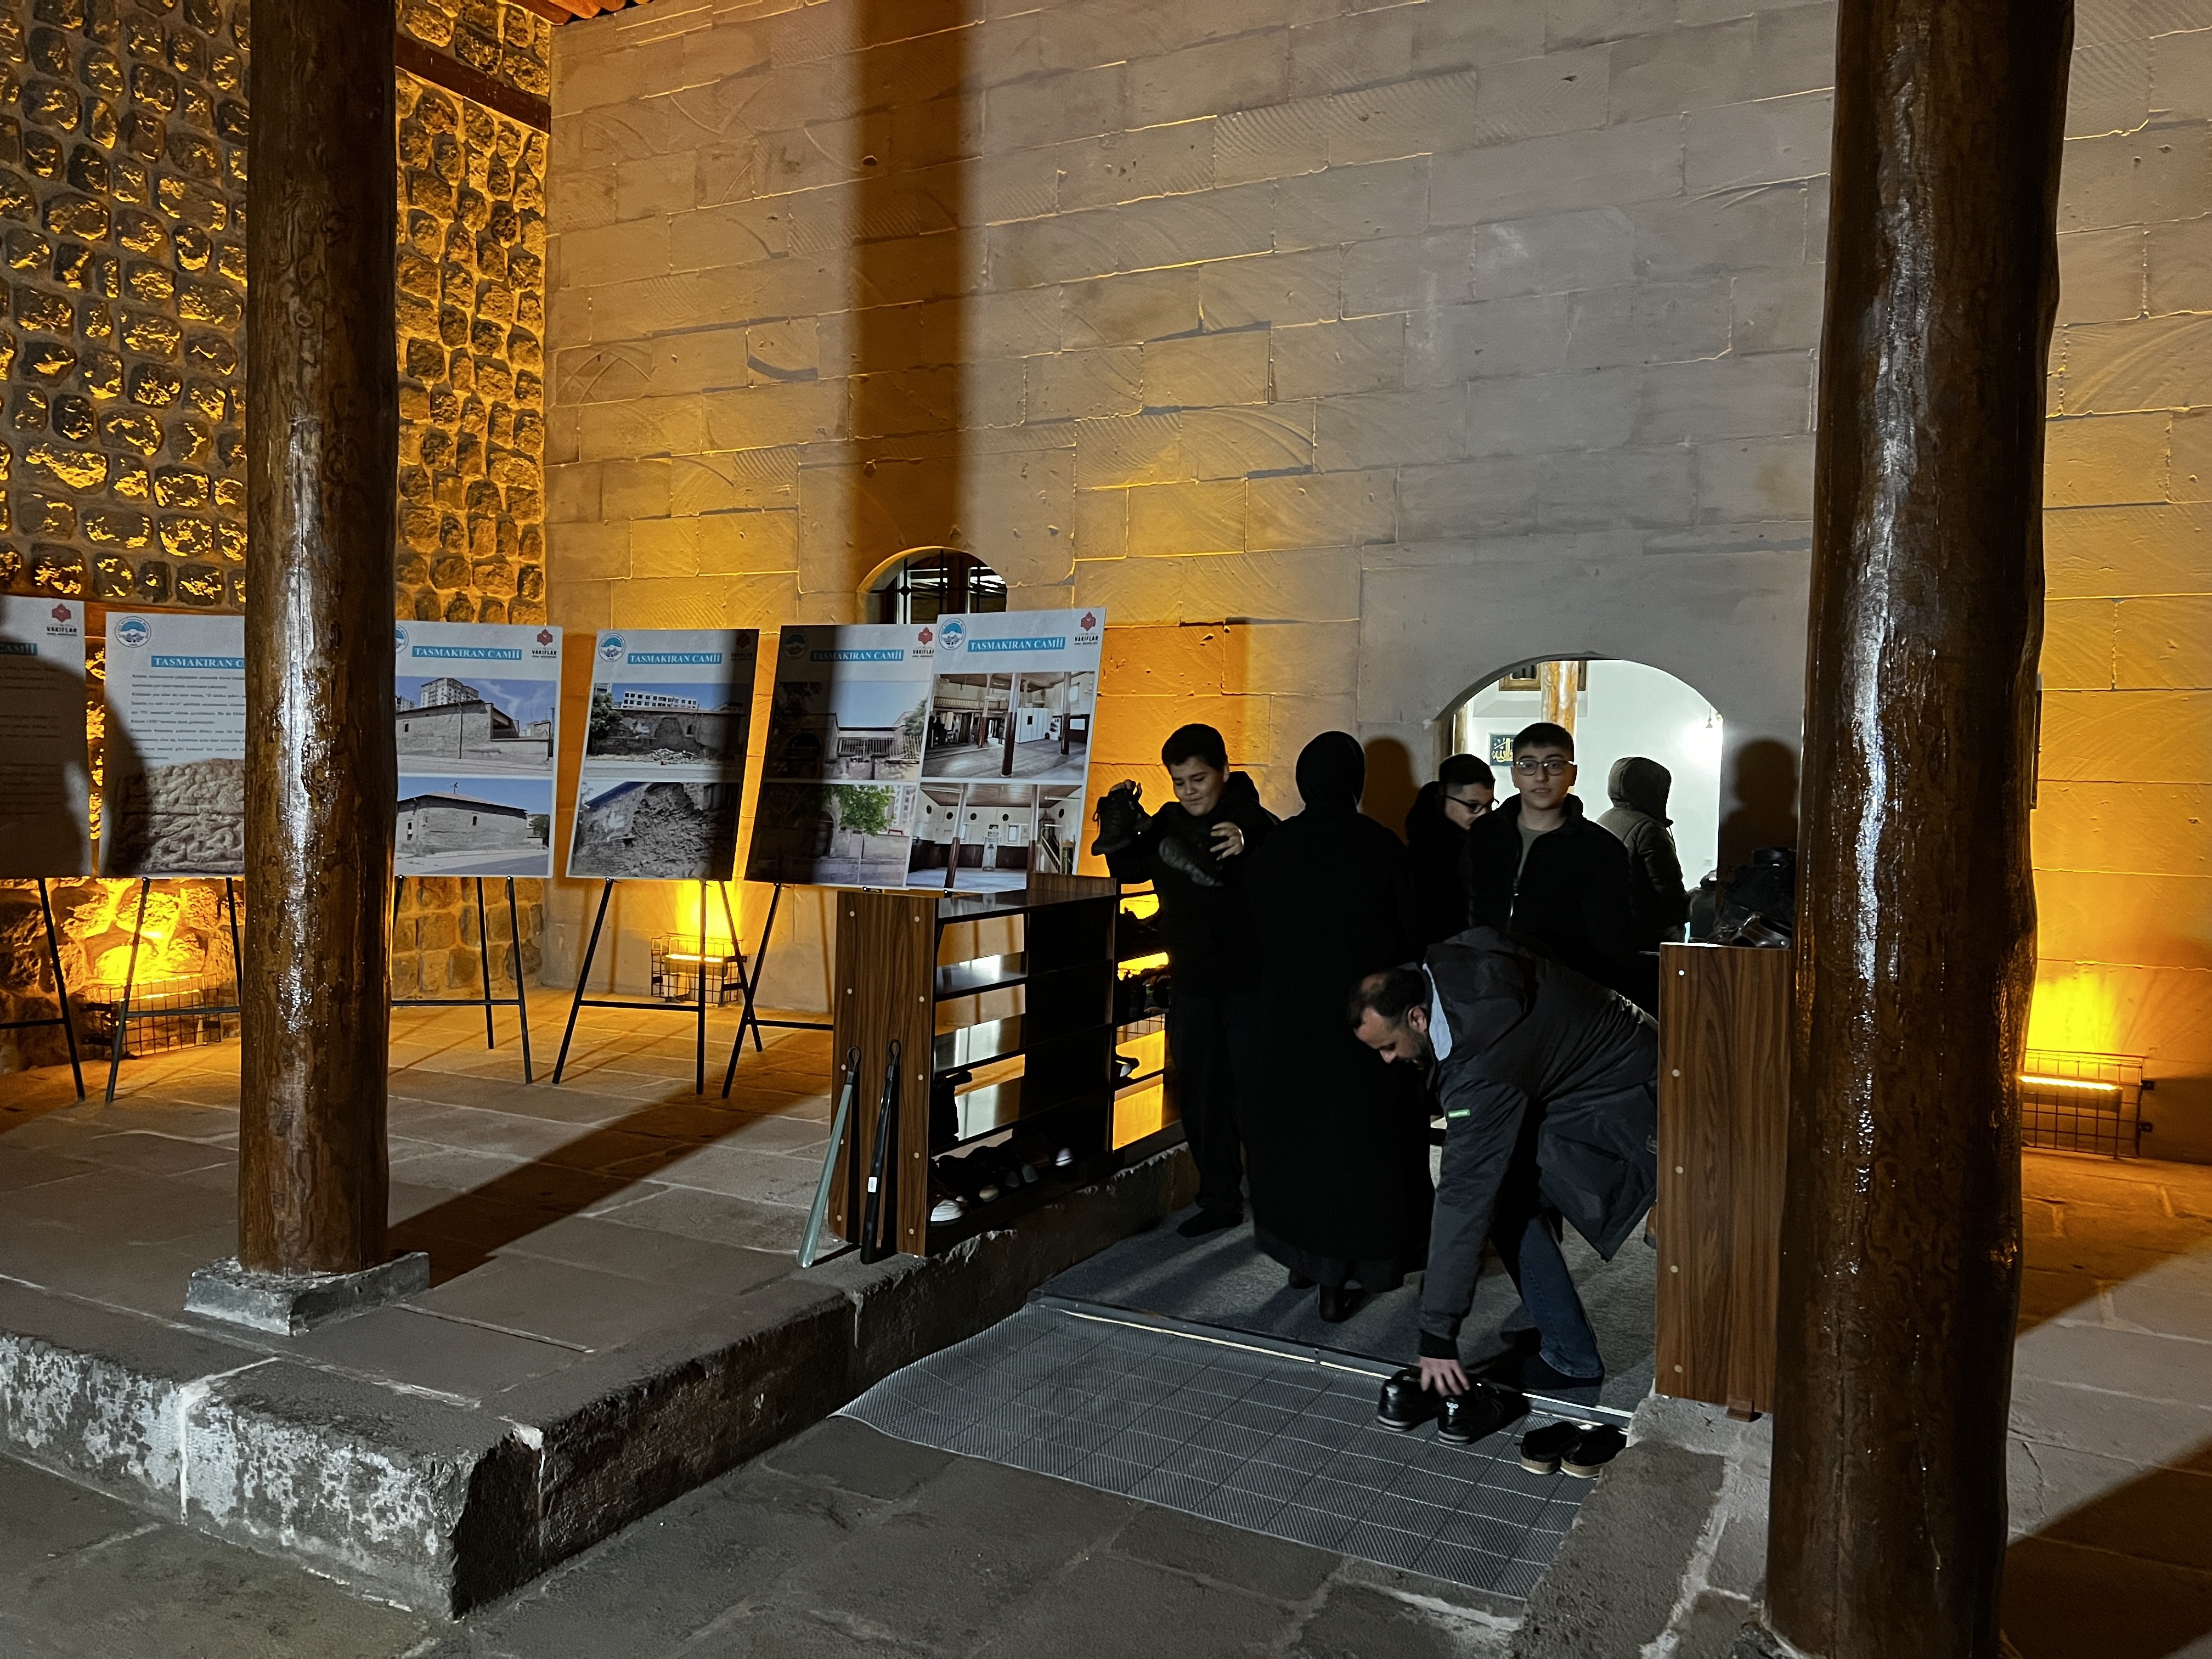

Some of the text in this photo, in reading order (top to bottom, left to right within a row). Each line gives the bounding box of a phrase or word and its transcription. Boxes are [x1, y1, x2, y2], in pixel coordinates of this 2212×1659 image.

[970, 640, 1031, 651] TASMAKIRAN
[414, 647, 485, 658] TASMAKIRAN
[154, 657, 232, 668] TASMAKIRAN
[630, 655, 691, 663] TASMAKIRAN
